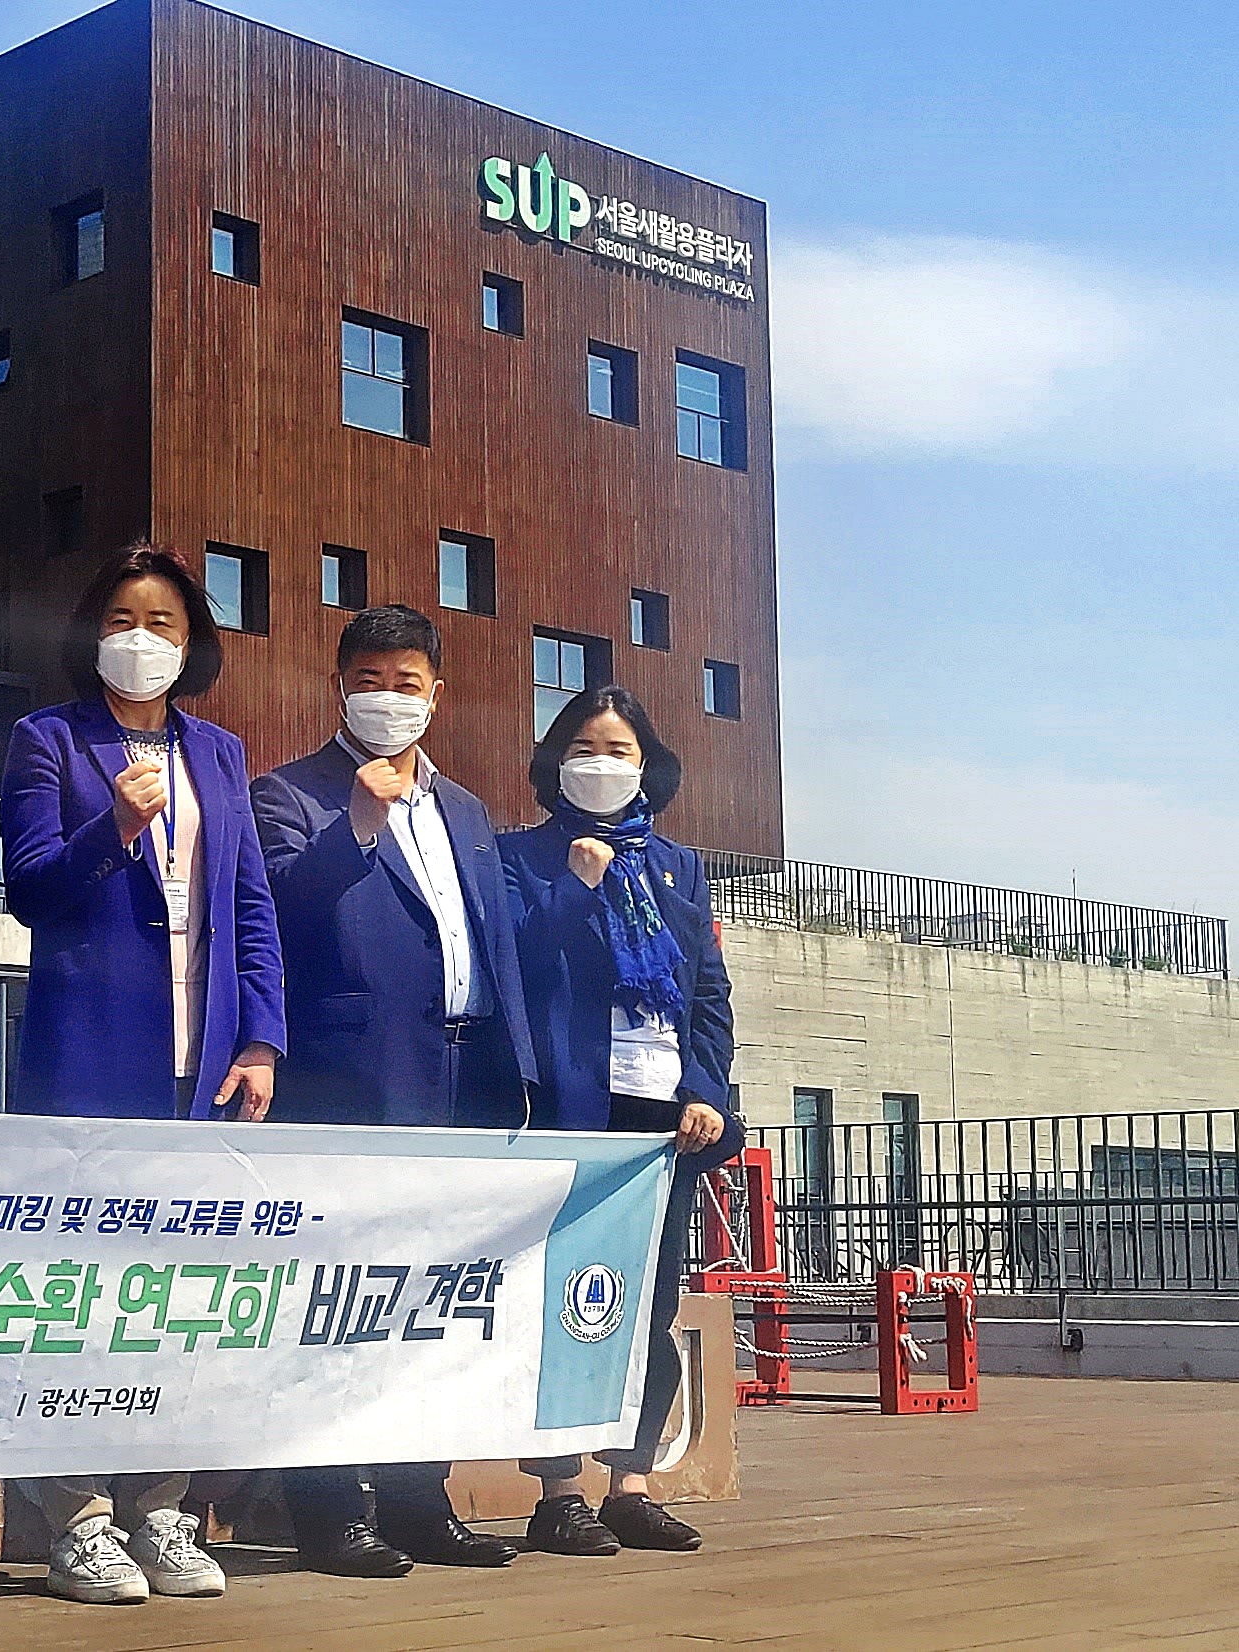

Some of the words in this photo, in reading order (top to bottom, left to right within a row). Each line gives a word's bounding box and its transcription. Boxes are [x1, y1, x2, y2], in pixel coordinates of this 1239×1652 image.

[482, 151, 591, 243] SUP
[595, 195, 753, 276] 서울새활용플라자
[595, 237, 641, 265] SEOUL
[641, 250, 712, 288] UPCYCLING
[714, 275, 755, 302] PLAZA
[58, 1197, 93, 1234] 및
[97, 1198, 159, 1235] 정책
[160, 1199, 245, 1236] 교류를
[249, 1200, 303, 1237] 위한
[108, 1257, 300, 1354] 연구회'
[298, 1264, 411, 1346] 비교
[401, 1257, 504, 1342] 견학
[37, 1386, 162, 1418] 광산구의회
